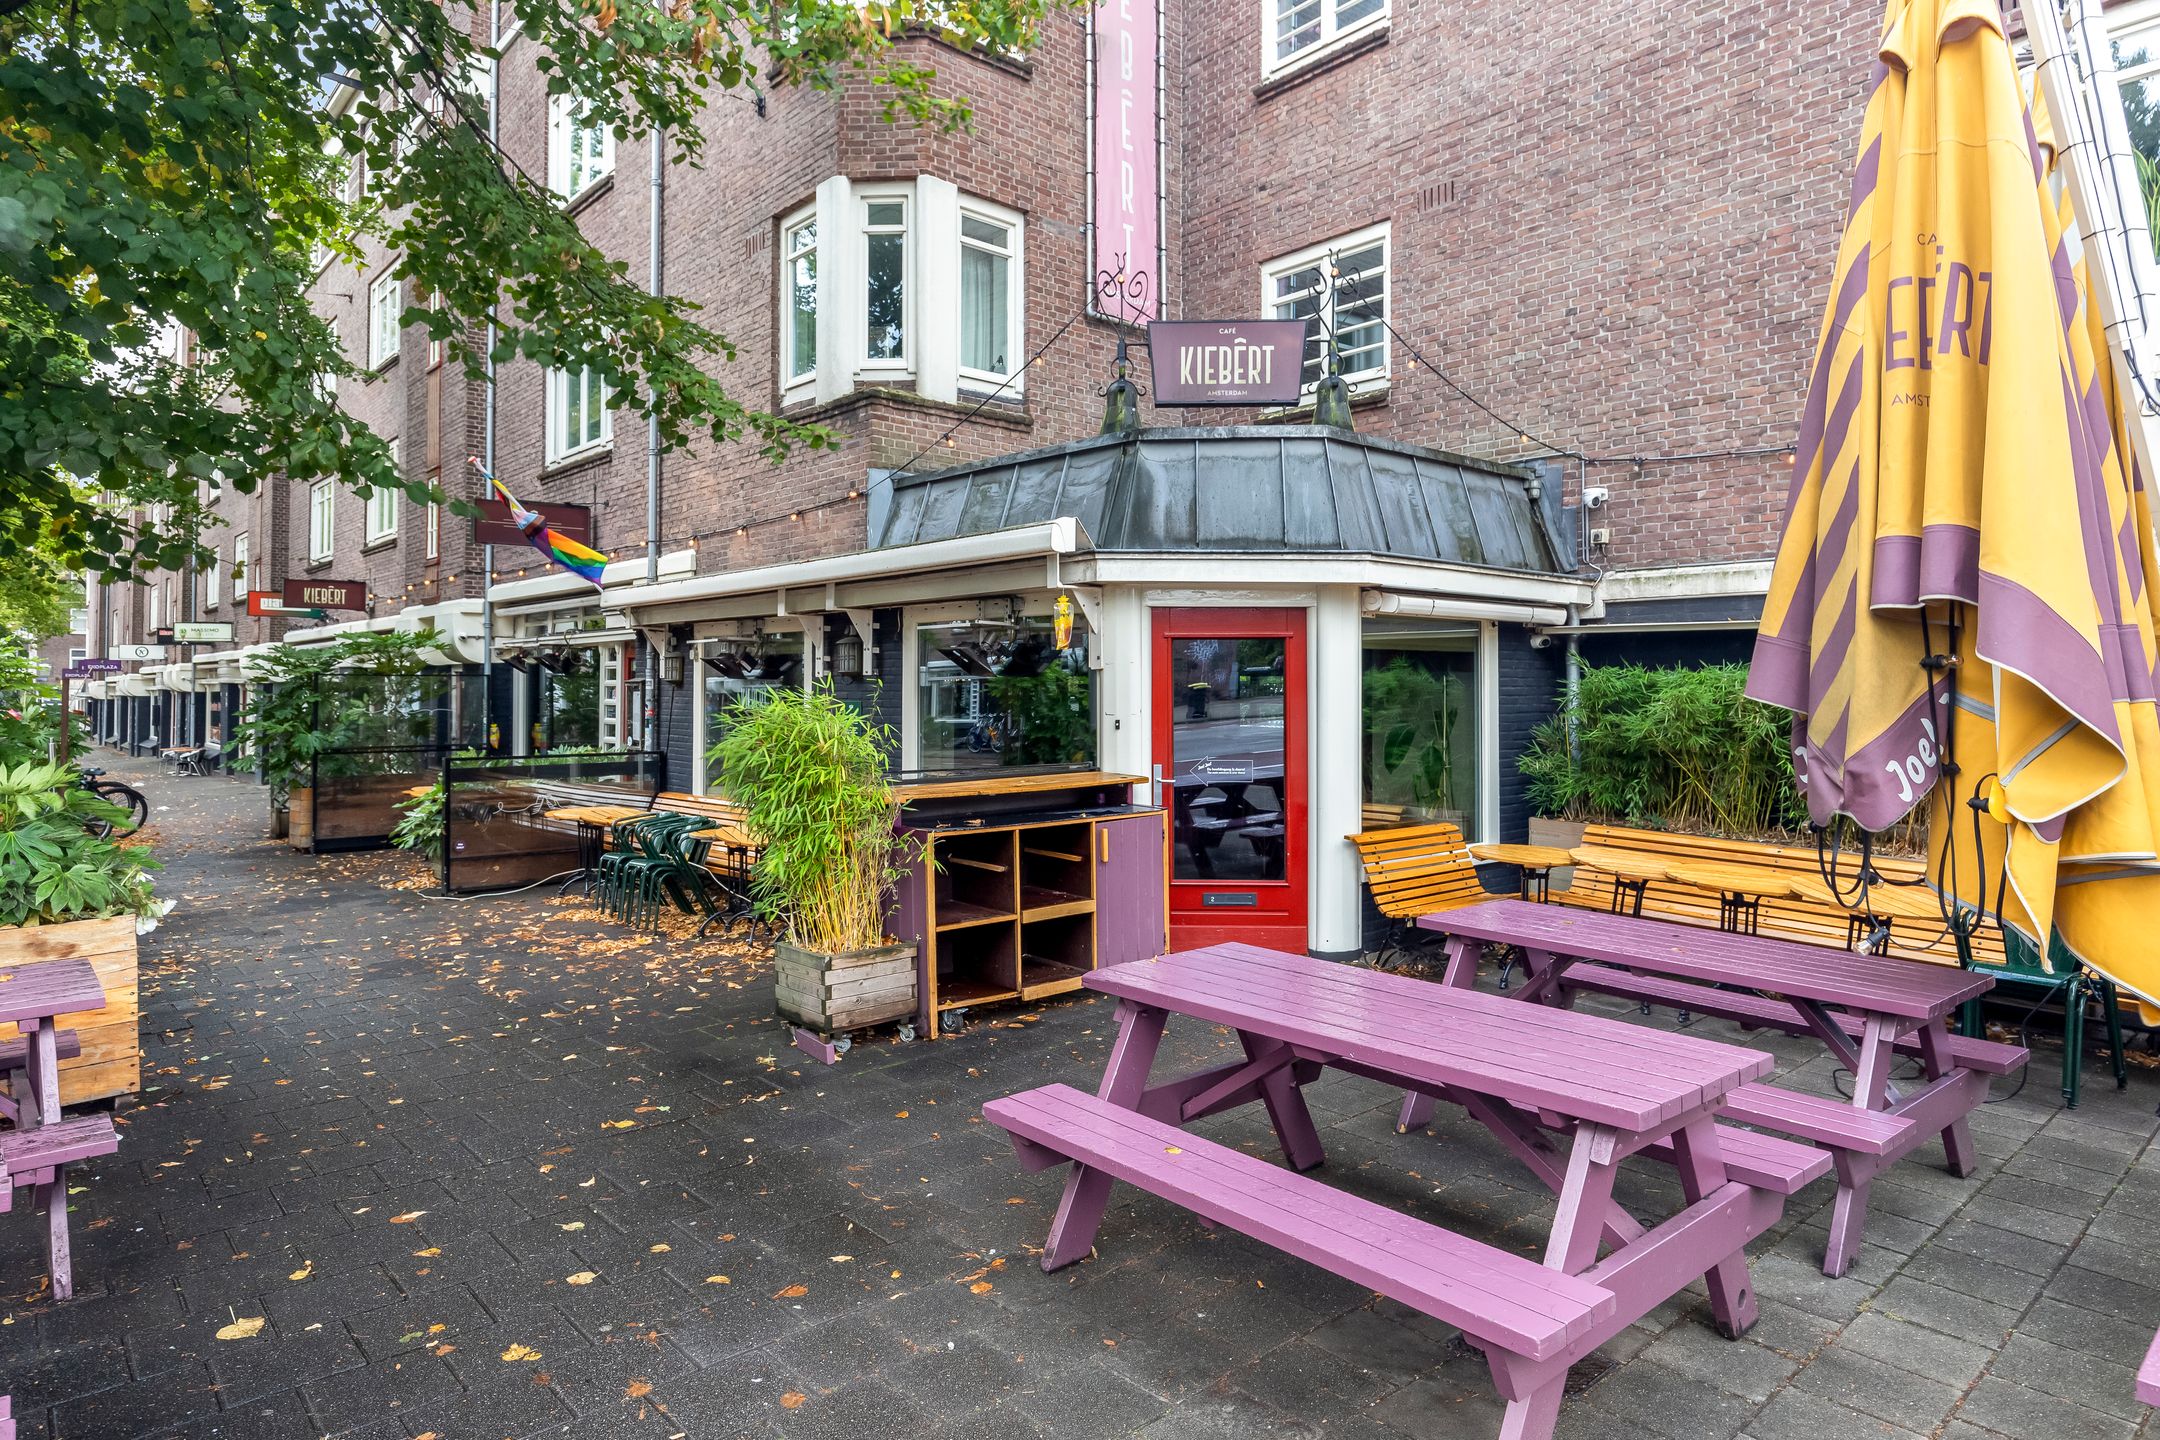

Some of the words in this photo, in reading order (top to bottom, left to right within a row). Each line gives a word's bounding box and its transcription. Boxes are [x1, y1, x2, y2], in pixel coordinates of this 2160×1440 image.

[1219, 327, 1236, 335] CAFÉ
[1180, 337, 1275, 385] KIEBÊRT
[303, 585, 347, 605] KIEBÊRT
